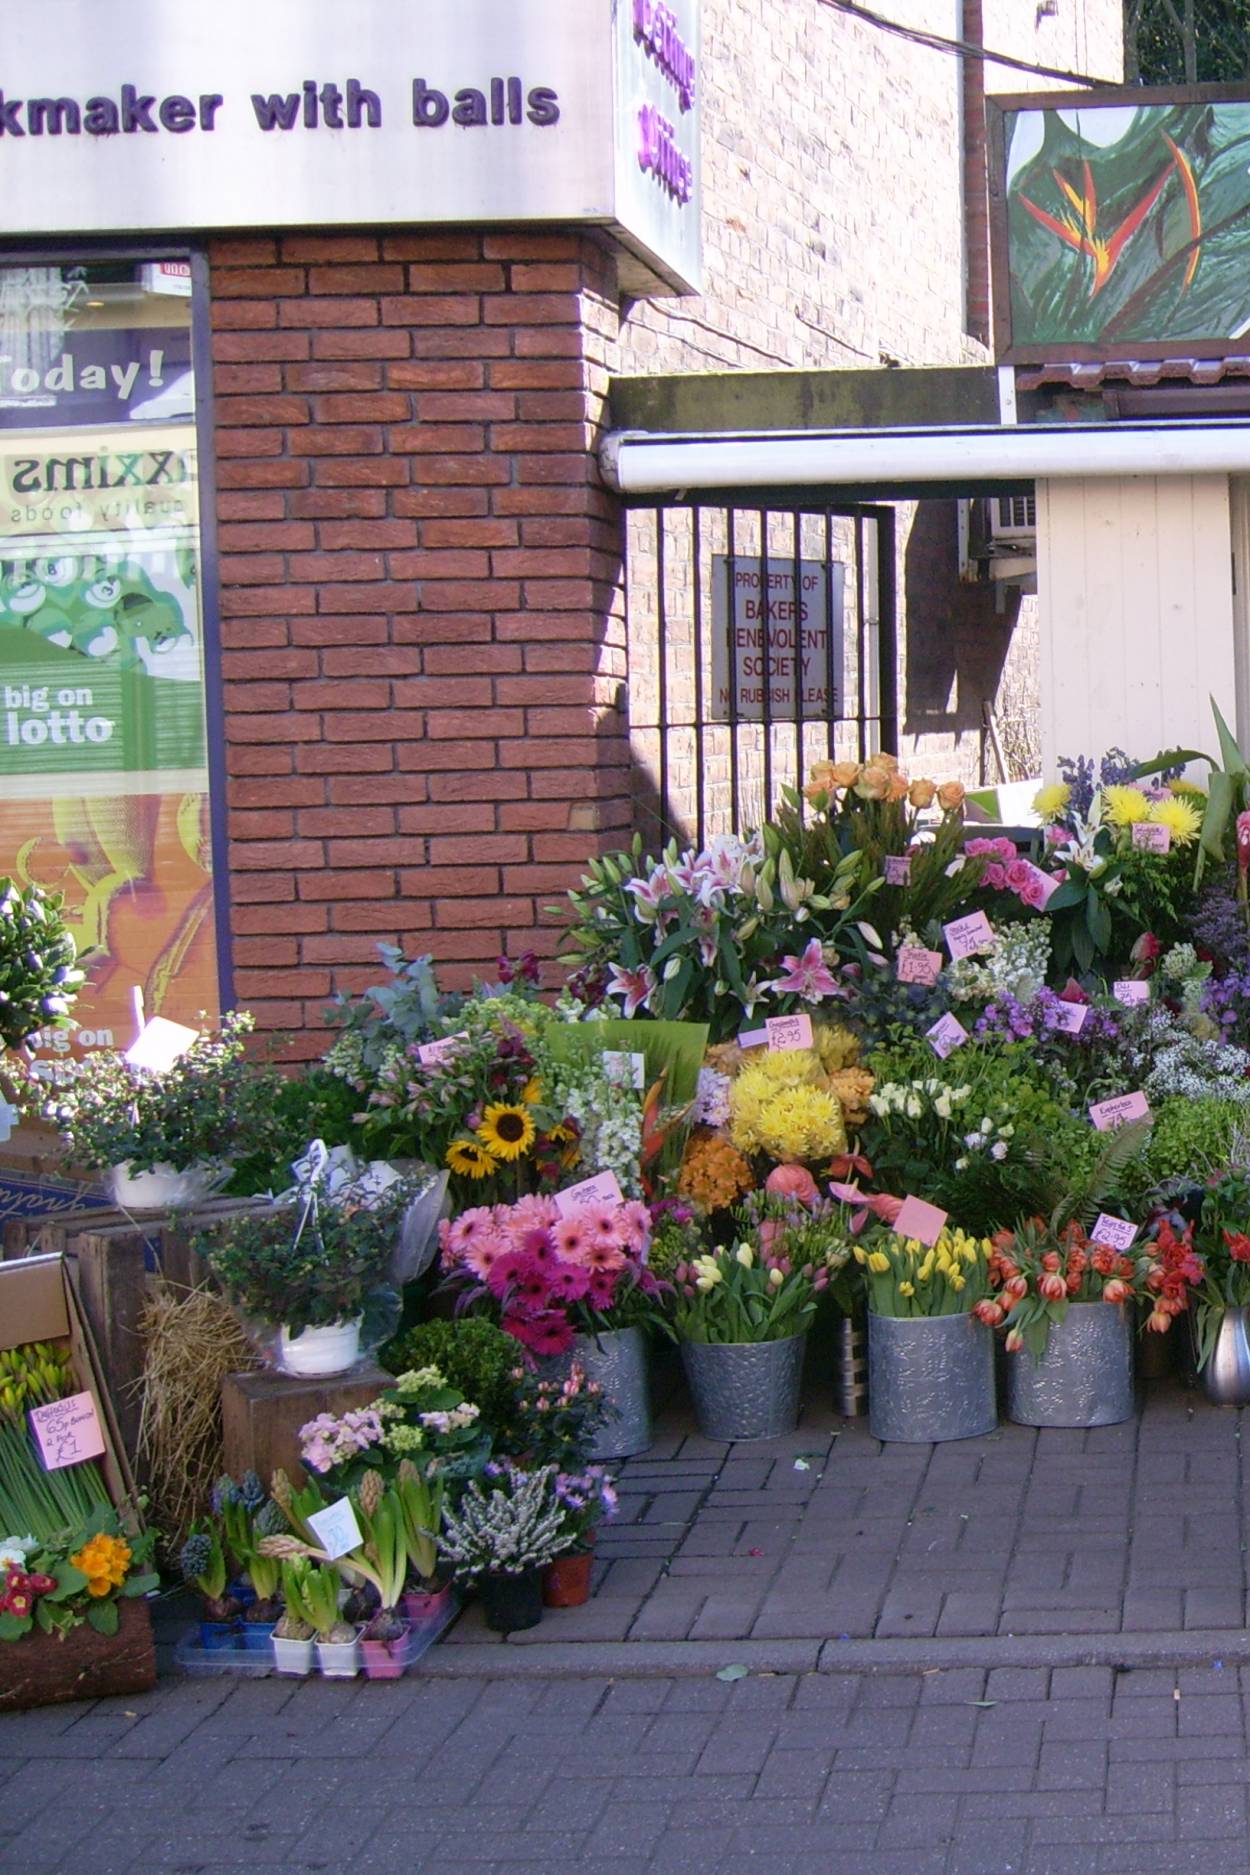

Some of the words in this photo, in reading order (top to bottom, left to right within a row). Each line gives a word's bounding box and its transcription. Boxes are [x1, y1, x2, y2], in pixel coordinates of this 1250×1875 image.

[251, 78, 382, 131] with
[412, 77, 560, 129] balls
[0, 349, 164, 399] oday!
[803, 576, 819, 591] OF
[4, 685, 50, 712] big
[58, 687, 93, 707] on
[8, 711, 116, 745] lotto
[78, 1029, 113, 1047] on
